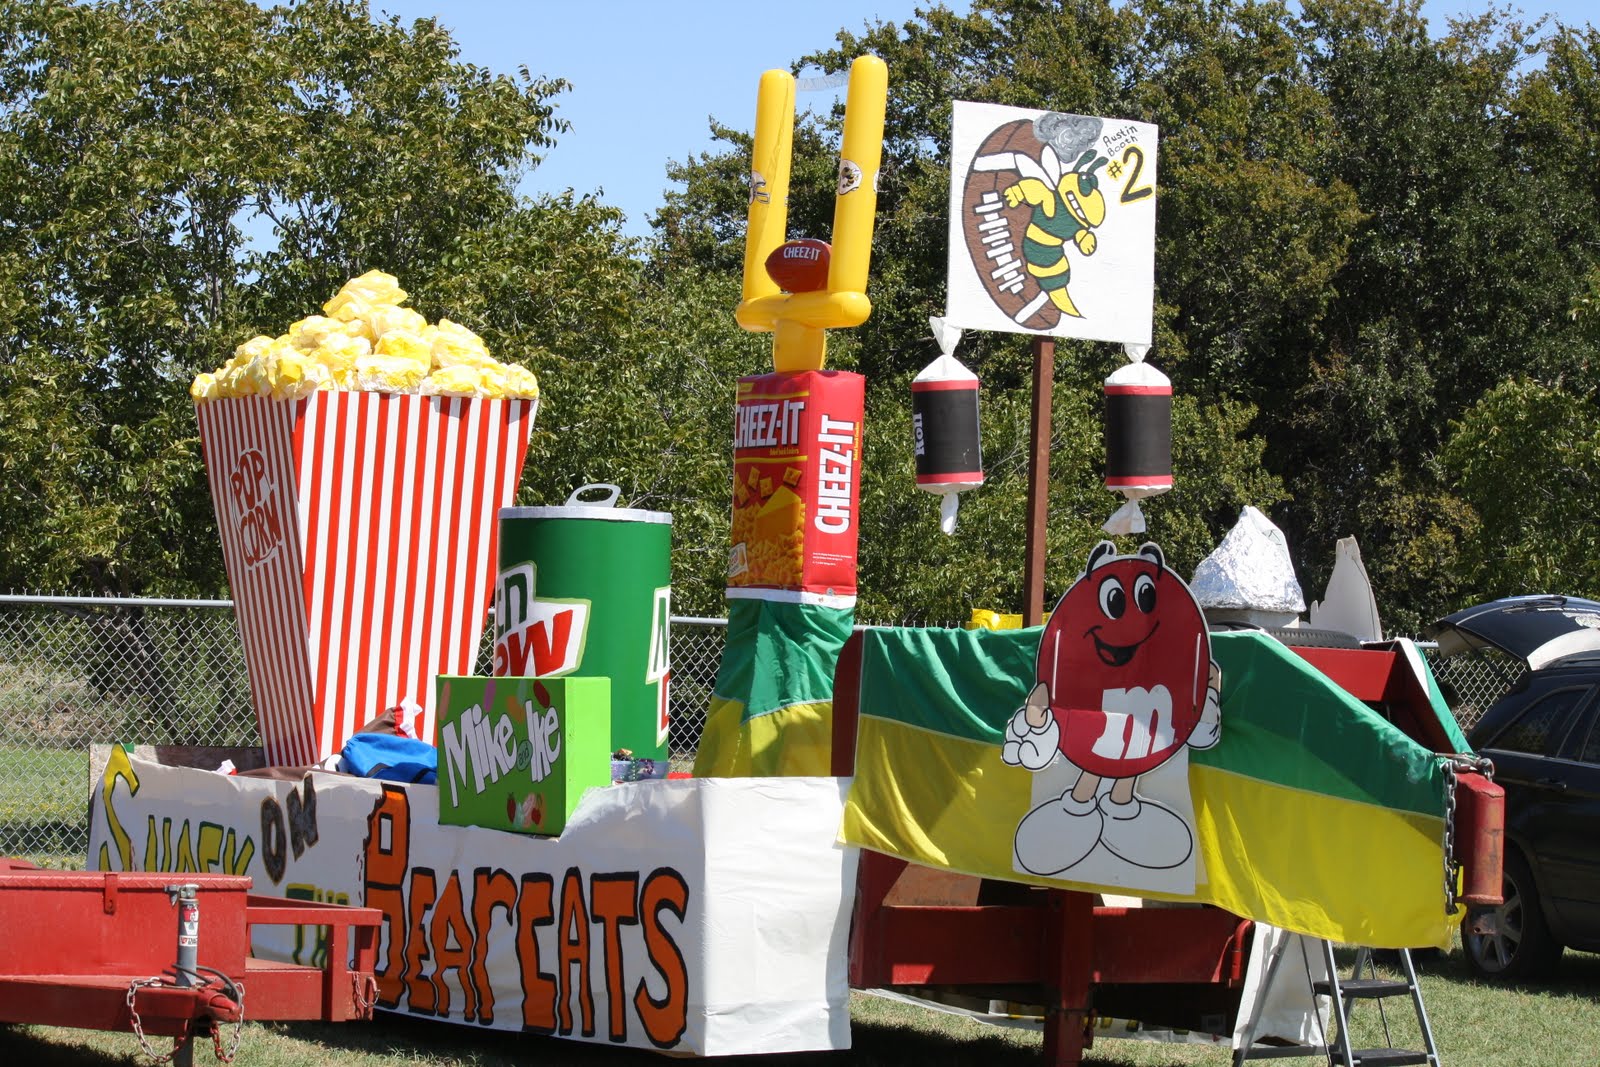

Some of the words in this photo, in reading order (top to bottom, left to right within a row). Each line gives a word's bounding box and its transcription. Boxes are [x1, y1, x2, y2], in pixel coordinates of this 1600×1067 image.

[1103, 125, 1138, 147] Austin
[1107, 135, 1138, 157] Booth
[1107, 145, 1153, 203] #2
[783, 246, 821, 261] CHEEZ-IT
[231, 450, 265, 516] POP
[814, 414, 855, 535] CHEEZ-IT
[240, 490, 282, 566] CORN
[442, 703, 517, 808] Mike
[525, 700, 561, 783] Ike
[261, 773, 319, 885] ON
